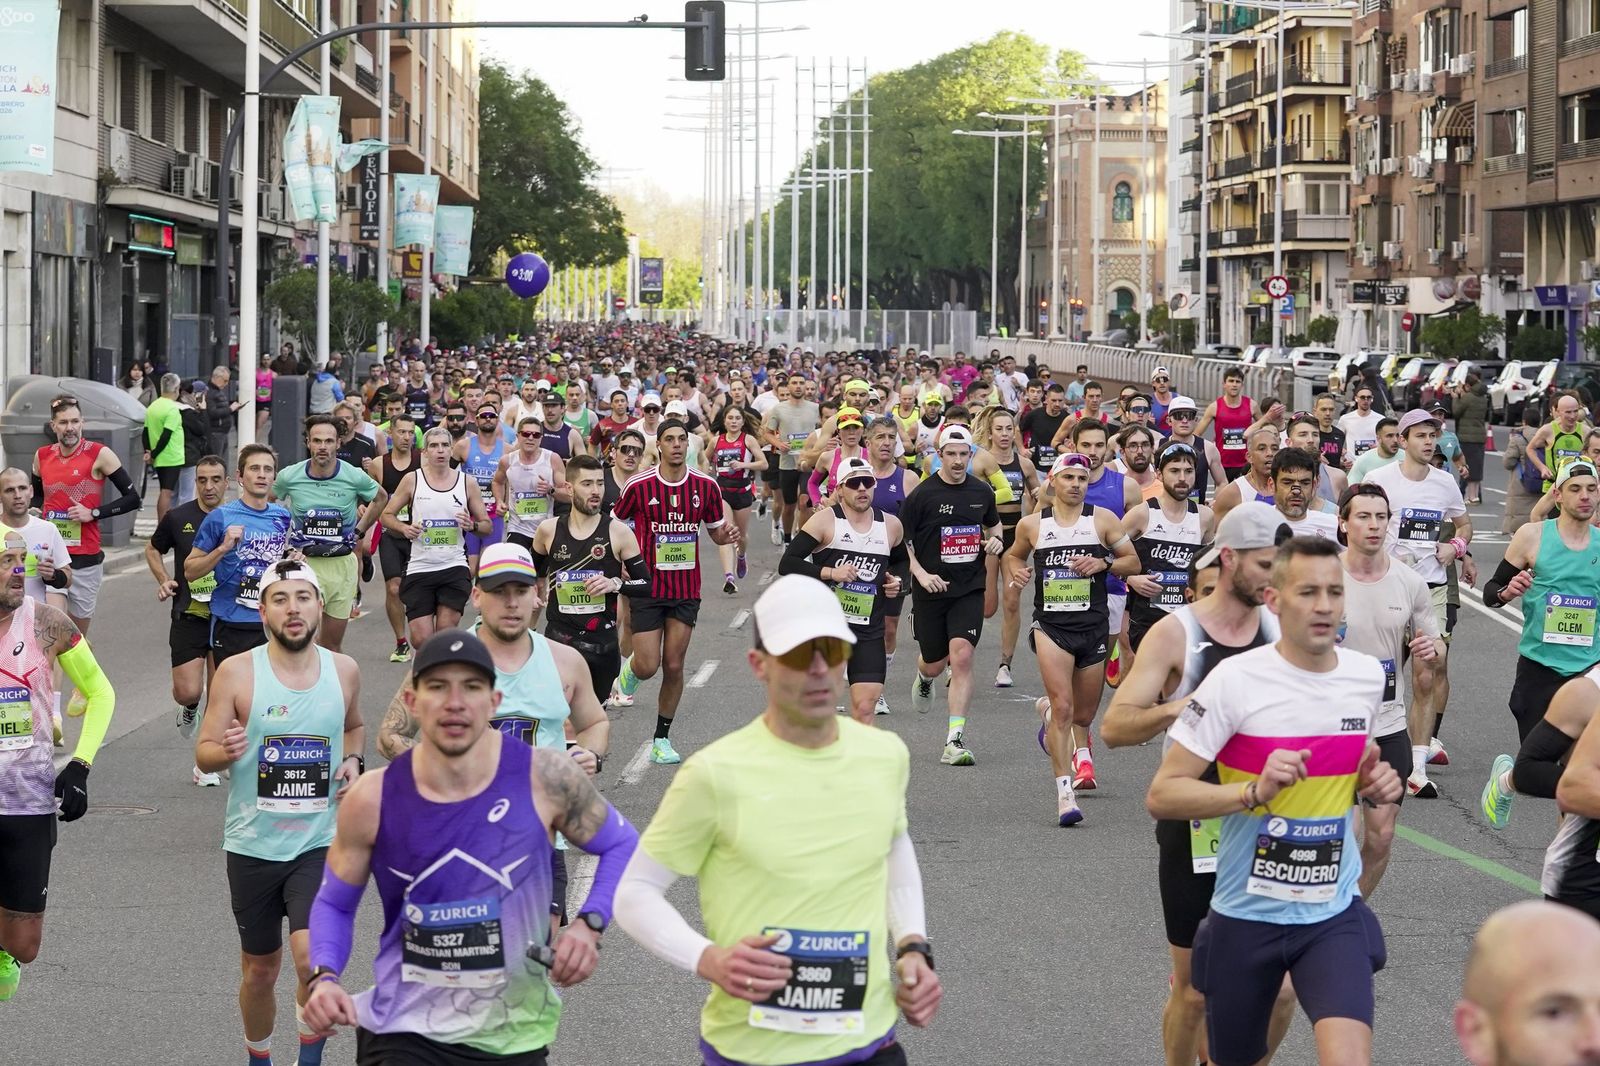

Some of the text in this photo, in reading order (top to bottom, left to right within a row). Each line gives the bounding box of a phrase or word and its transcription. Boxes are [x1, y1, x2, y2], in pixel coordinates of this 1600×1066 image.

[365, 151, 377, 223] ENTOFT
[517, 269, 534, 282] 3:00
[668, 512, 684, 521] Fly
[1415, 511, 1438, 519] ZURICH
[307, 527, 338, 535] BASTIEN
[651, 521, 699, 533] Emirates
[1409, 530, 1429, 540] MIMI
[432, 537, 449, 545] JOSE
[941, 545, 980, 554] JACK RYAN
[665, 554, 687, 562] ROMS
[570, 594, 591, 604] DITO
[1044, 593, 1090, 602] SENÉN ALONSO
[1161, 594, 1183, 603] HUGO
[1564, 597, 1592, 607] ZURICH
[1563, 612, 1579, 620] 3247
[1557, 621, 1583, 633] CLEM
[284, 749, 323, 760] ZURICH
[284, 769, 307, 779] 3612
[272, 782, 316, 797] JAIME
[1292, 823, 1338, 837] ZURICH
[1289, 849, 1317, 862] 4998
[1252, 858, 1339, 883] ESCUDERO
[429, 904, 488, 922] ZURICH
[433, 933, 464, 947] 5327
[798, 936, 859, 951] ZURICH
[405, 941, 499, 959] SEBASTIAN MARTINS-
[441, 961, 461, 971] SON
[797, 966, 832, 983] 3860
[777, 985, 845, 1009] JAIME
